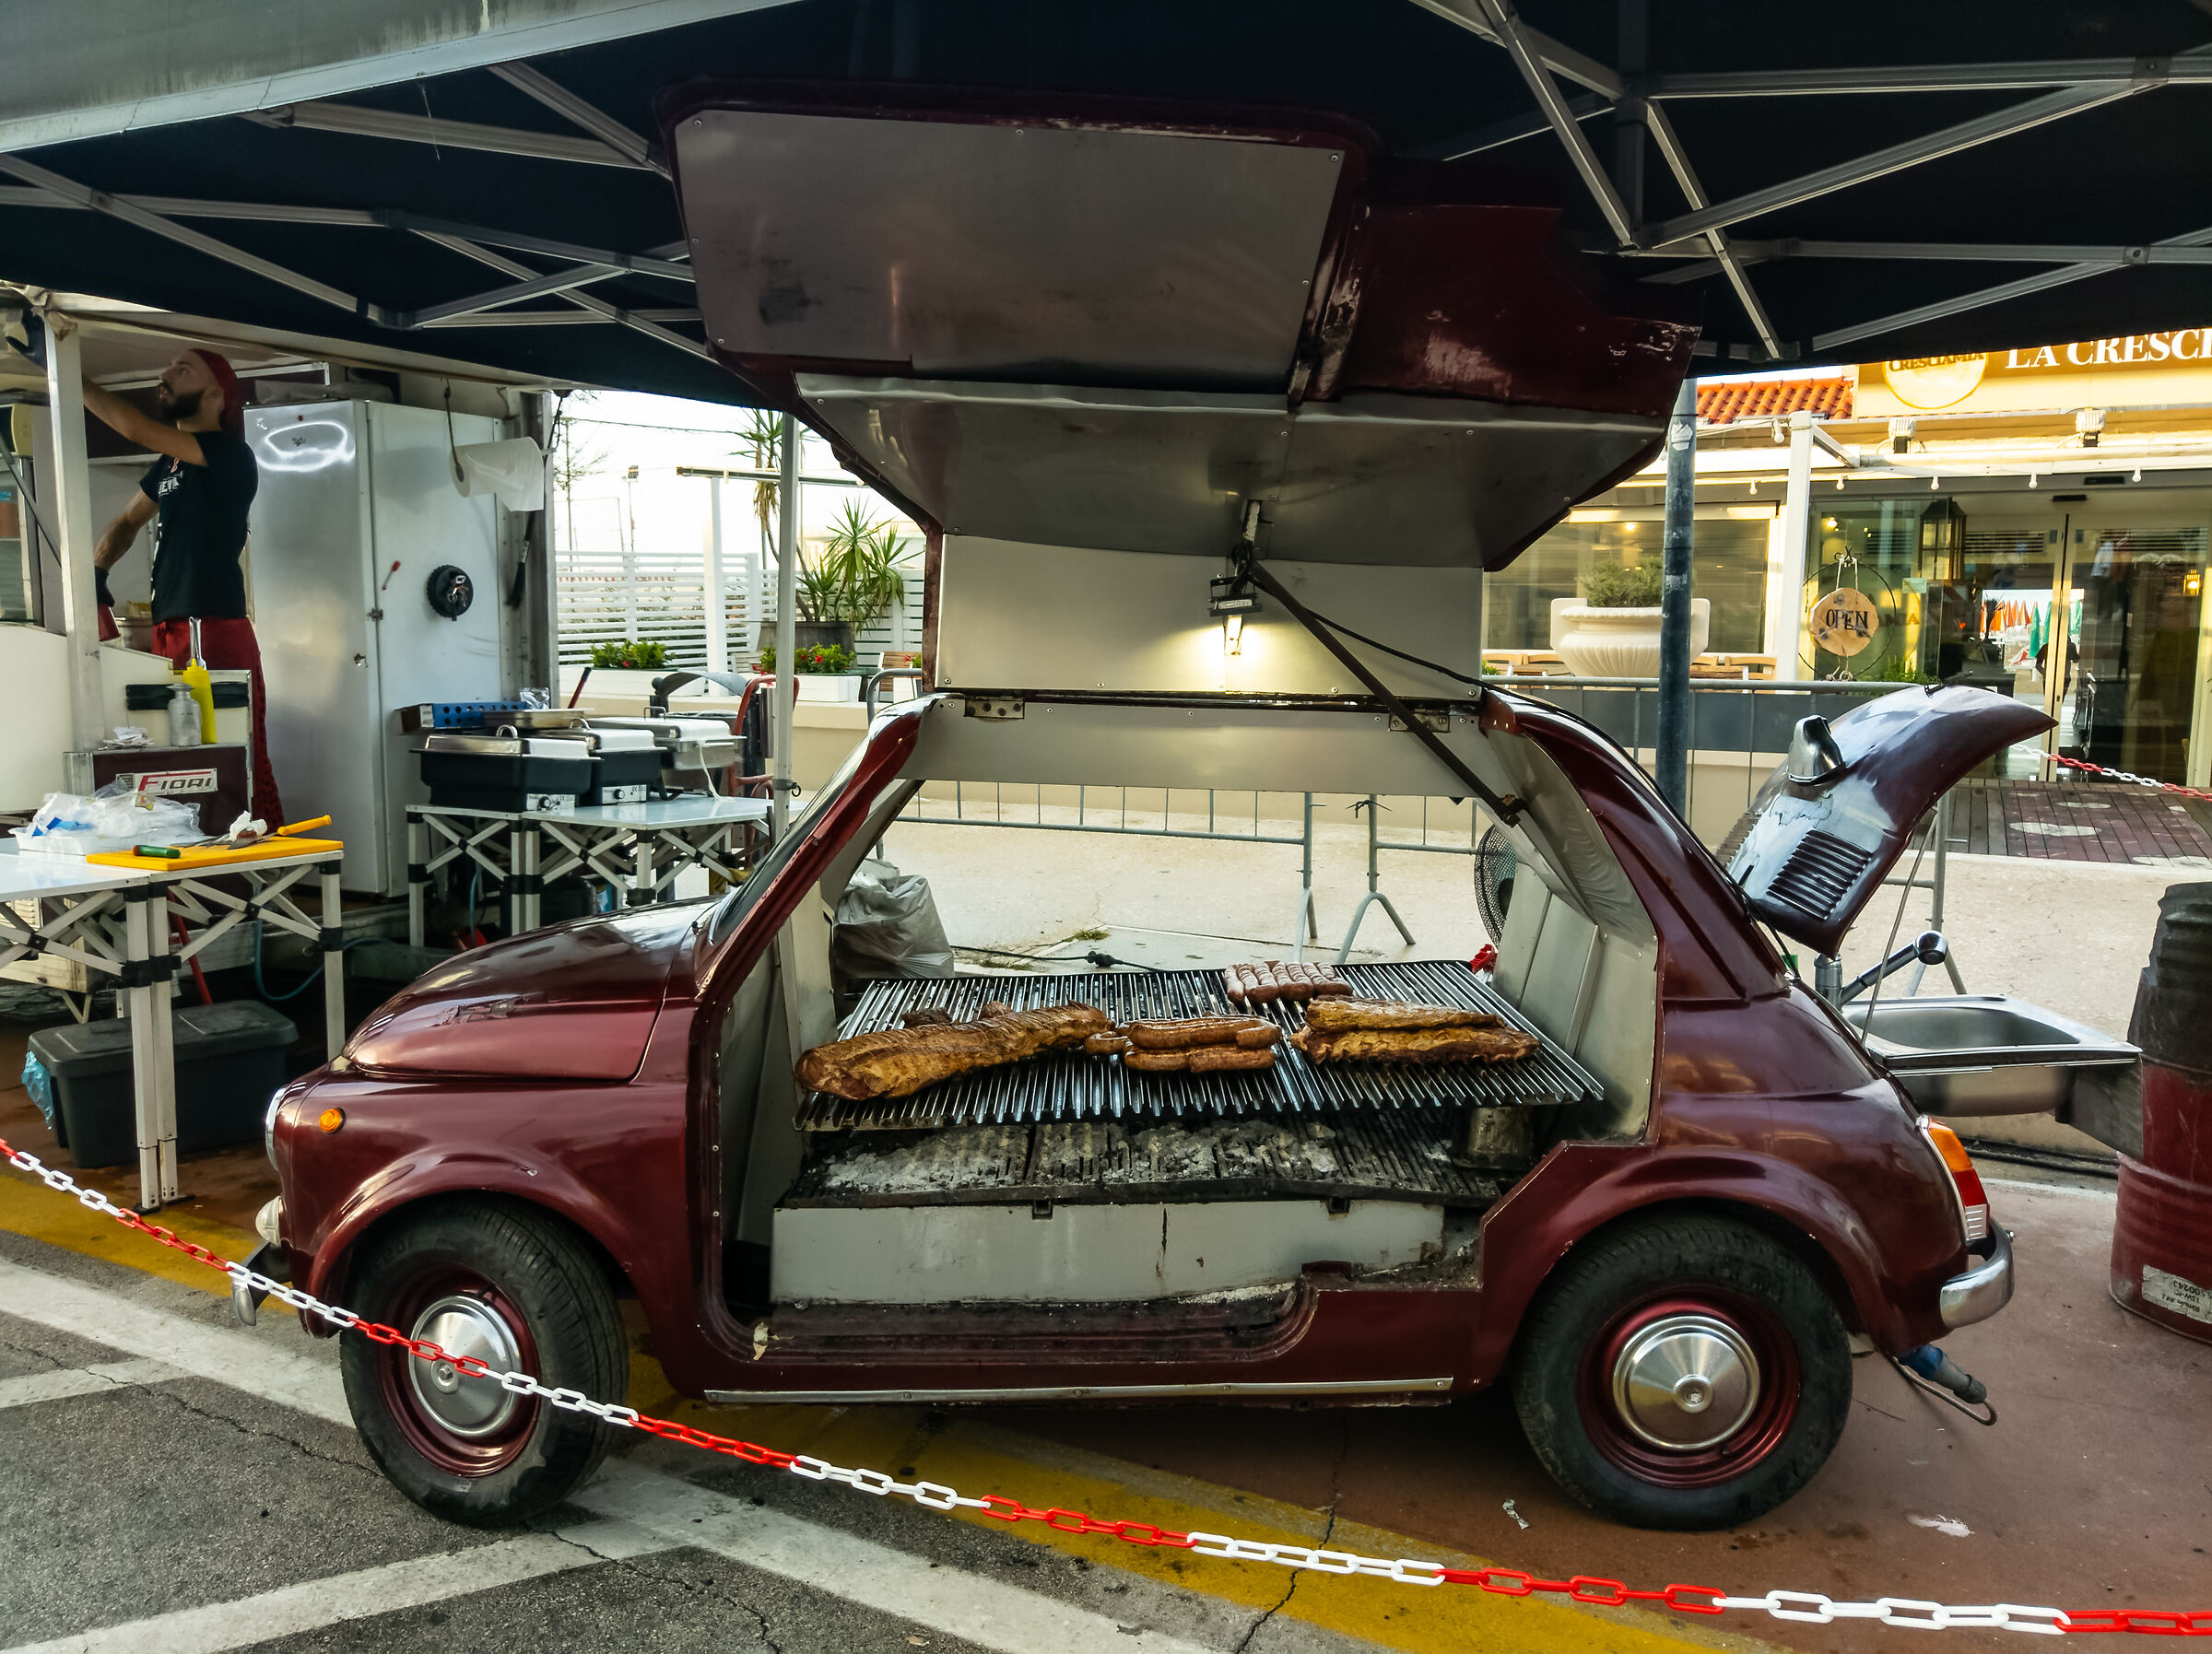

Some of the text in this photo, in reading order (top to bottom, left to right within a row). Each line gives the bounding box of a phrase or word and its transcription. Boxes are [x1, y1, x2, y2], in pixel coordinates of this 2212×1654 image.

[2006, 346, 2060, 369] LA
[1826, 608, 1868, 630] OPEN
[138, 771, 212, 792] FIORI
